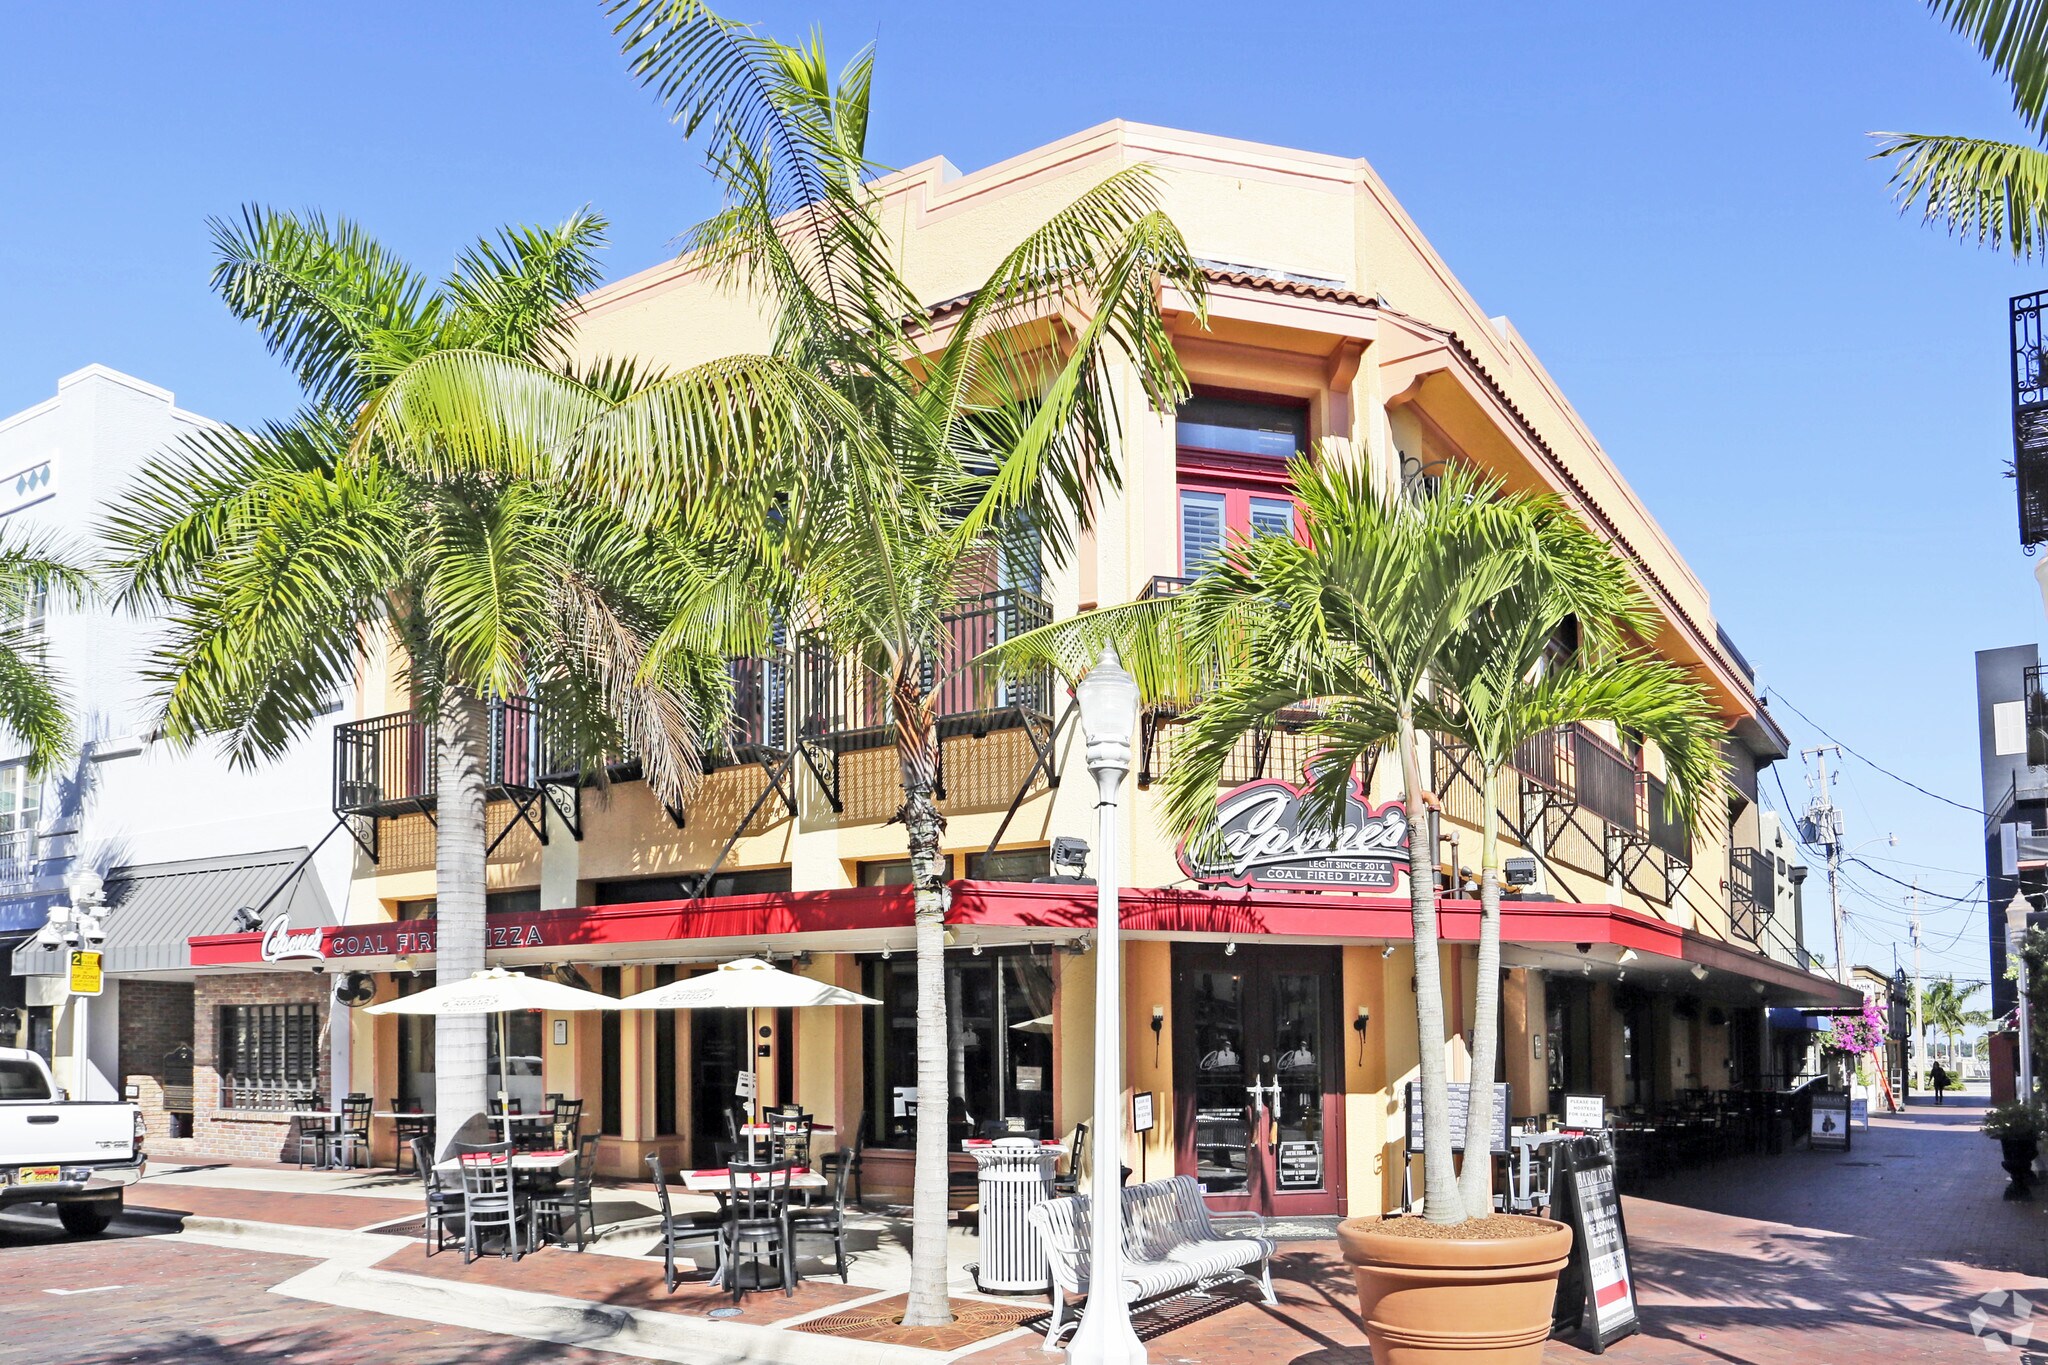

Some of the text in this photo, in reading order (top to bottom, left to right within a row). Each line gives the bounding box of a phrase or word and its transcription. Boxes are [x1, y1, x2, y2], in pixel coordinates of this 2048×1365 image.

[1308, 860, 1386, 871] LEGIT SINCE 2014
[1266, 869, 1385, 883] COAL FIRED PIZZA
[332, 935, 388, 955] COAL
[486, 926, 544, 947] IZZA
[72, 953, 81, 965] 2
[1575, 1165, 1612, 1188] BARCLAY'S
[1583, 1204, 1617, 1224] ANNUAL AND
[1588, 1218, 1617, 1237] SEASONAL
[1593, 1230, 1617, 1249] RENTALS
